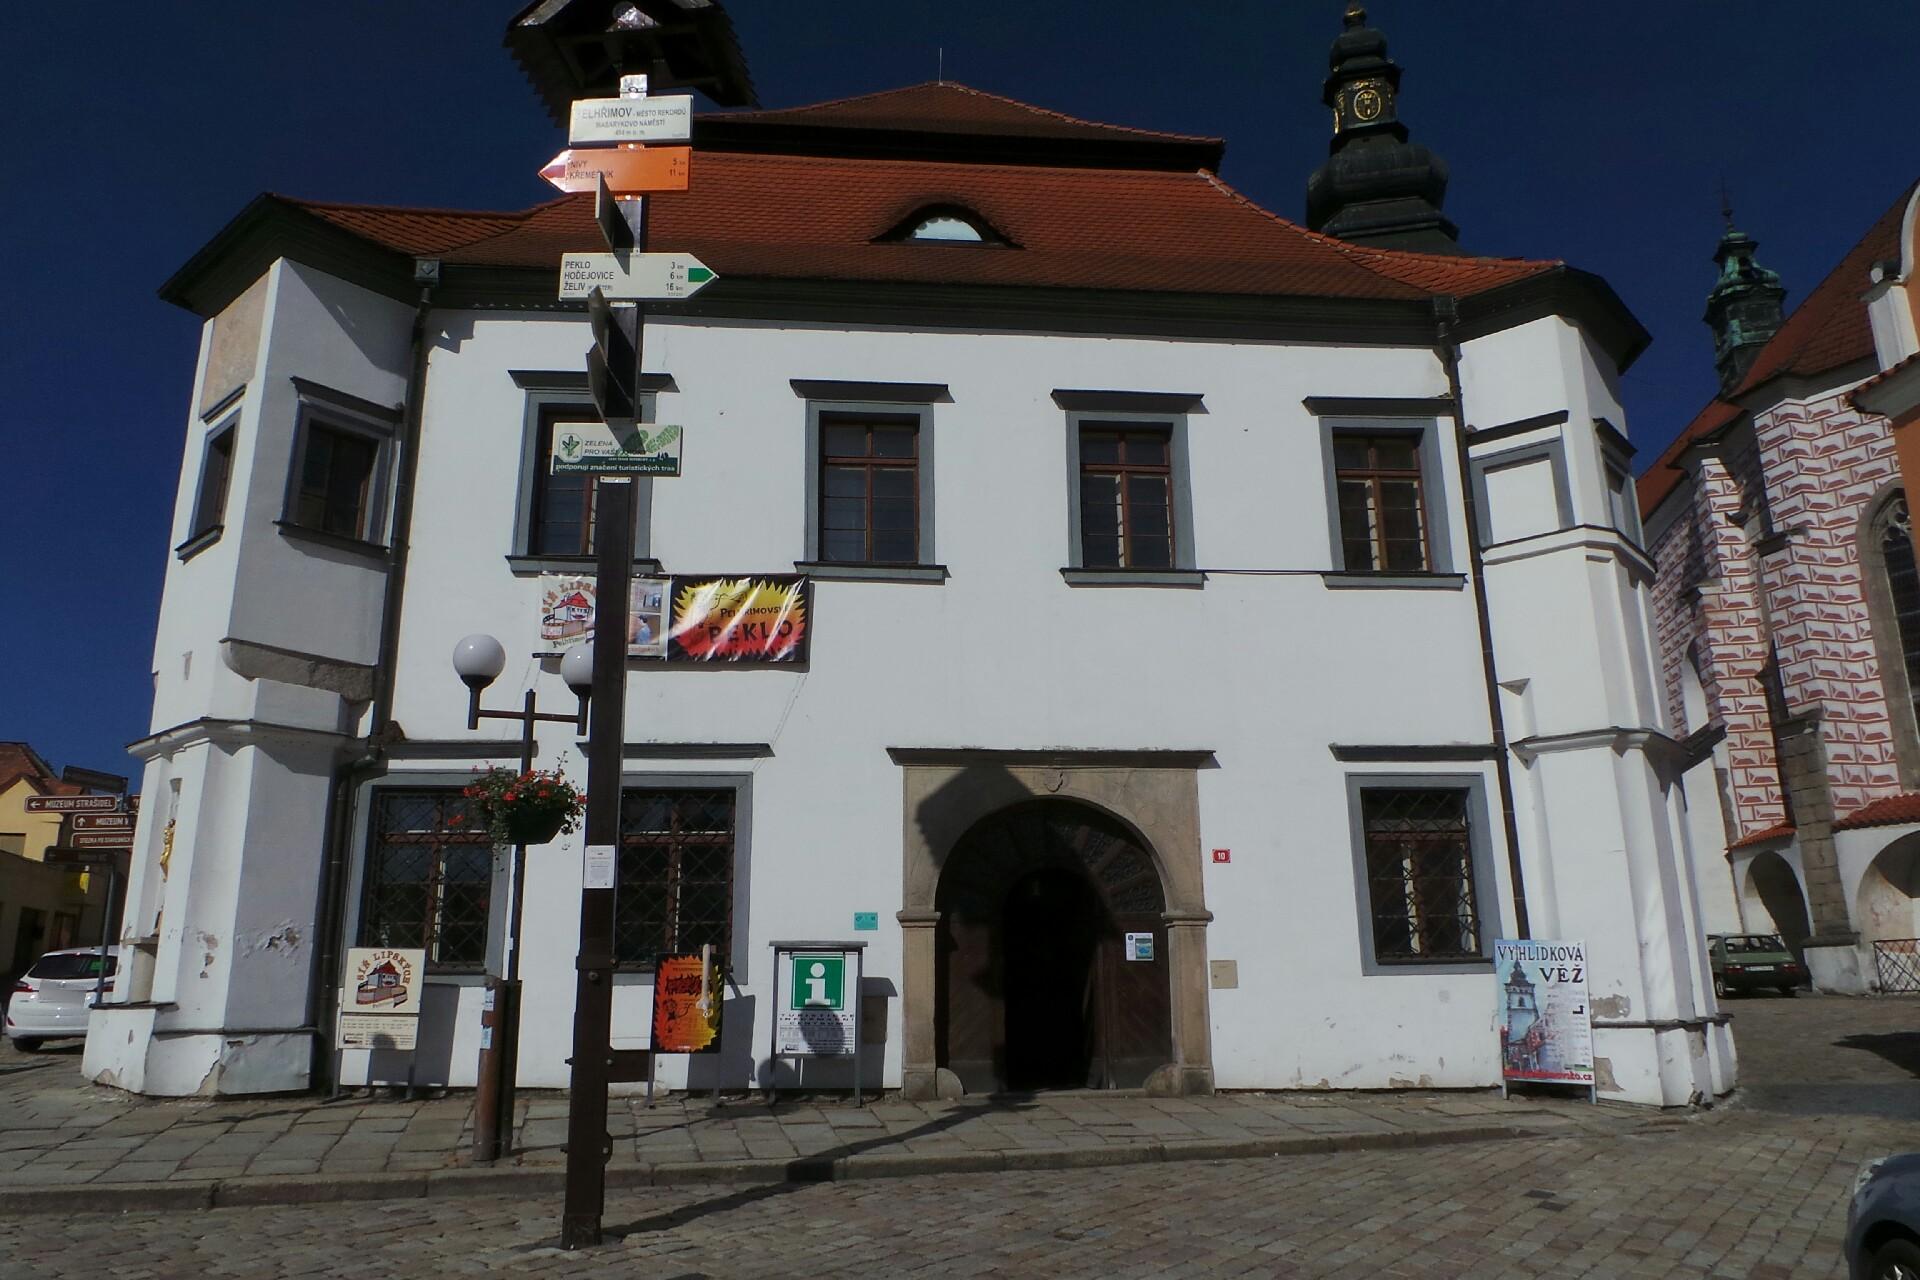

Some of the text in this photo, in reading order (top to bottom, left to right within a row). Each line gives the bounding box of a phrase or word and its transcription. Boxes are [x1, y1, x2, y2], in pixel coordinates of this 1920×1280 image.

[571, 160, 588, 168] NIVY
[565, 261, 590, 269] PEKLO
[671, 261, 675, 269] 3
[671, 271, 675, 279] 6
[563, 282, 586, 291] ŽELIV
[666, 283, 674, 291] 16
[589, 462, 617, 471] značení
[618, 463, 659, 472] turistických
[709, 619, 793, 642] PEKLO
[46, 800, 75, 809] MUZEUM
[1539, 964, 1583, 983] VĚŽ
